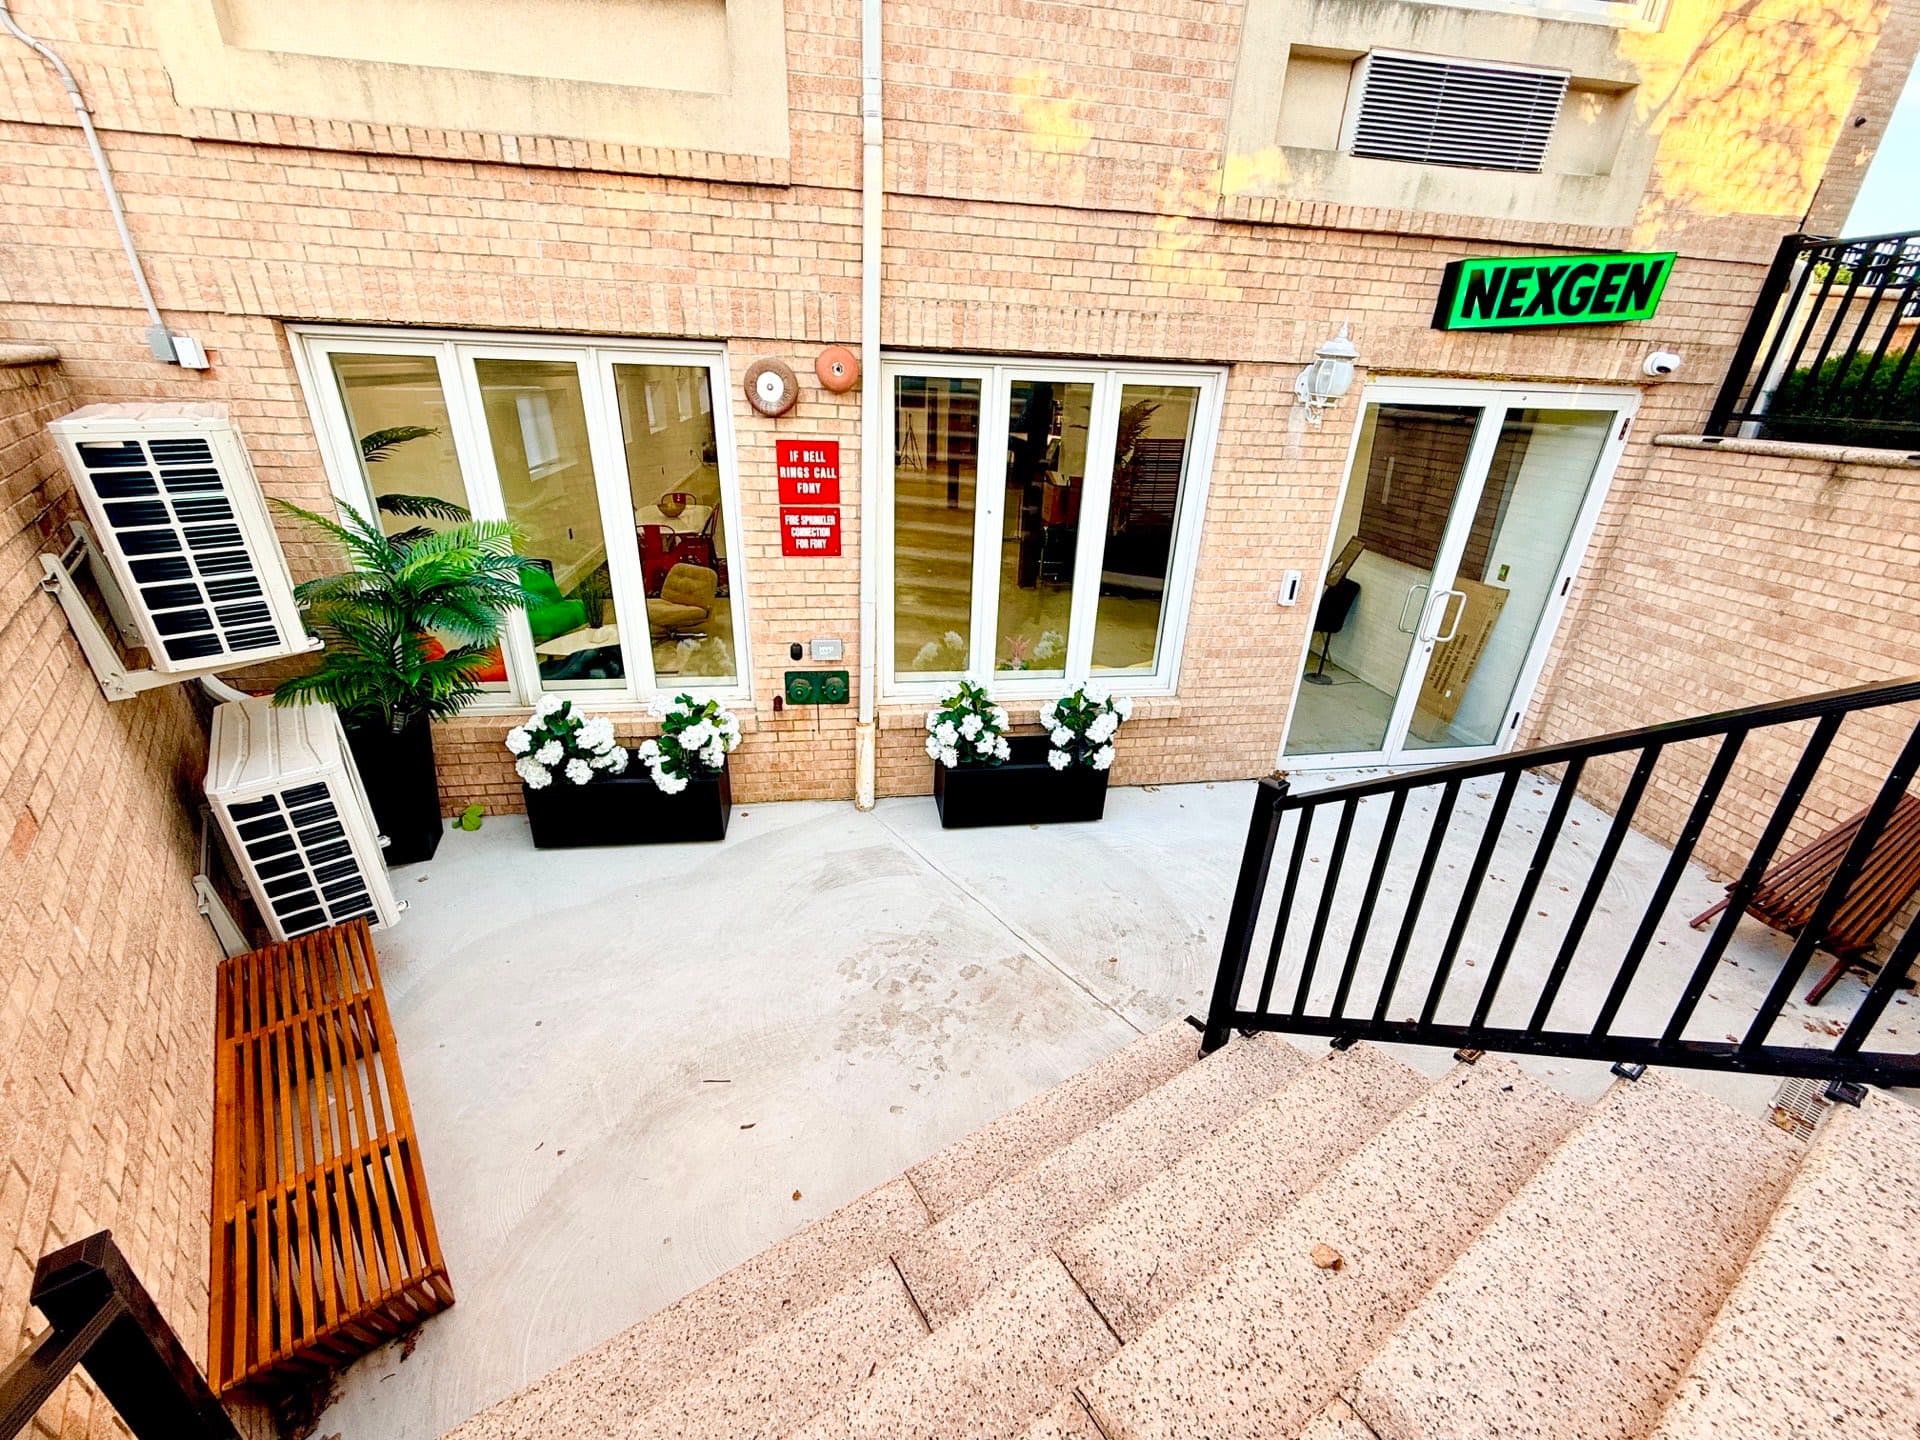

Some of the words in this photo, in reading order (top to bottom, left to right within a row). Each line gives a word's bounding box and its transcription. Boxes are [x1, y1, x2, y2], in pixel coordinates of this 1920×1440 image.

[1460, 259, 1665, 320] NEXGEN
[789, 450, 799, 463] IF
[803, 450, 826, 463] BELL
[780, 466, 810, 479] RINGS
[814, 466, 837, 479] CALL
[797, 482, 821, 494] FDNY
[785, 514, 800, 525] FIRE
[801, 514, 835, 526] SPRINKLER
[791, 527, 831, 537] CONNECTION
[796, 539, 809, 549] FOR
[810, 539, 827, 549] FDNY
